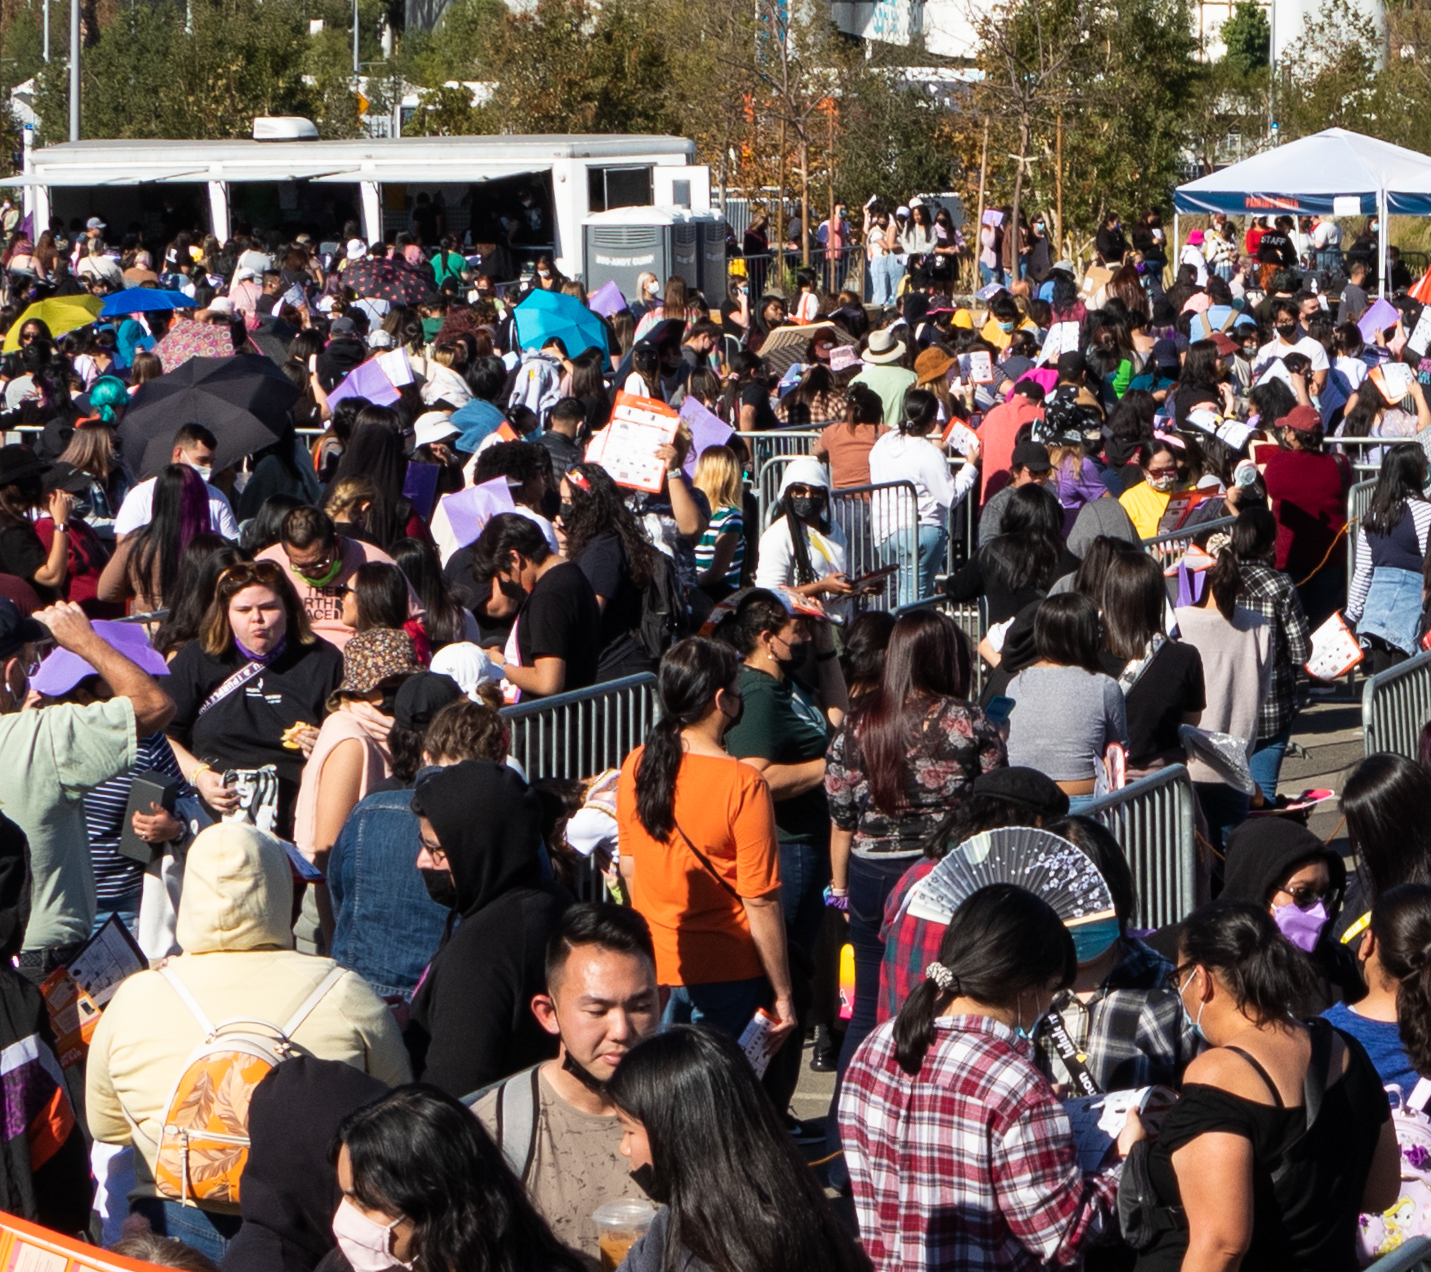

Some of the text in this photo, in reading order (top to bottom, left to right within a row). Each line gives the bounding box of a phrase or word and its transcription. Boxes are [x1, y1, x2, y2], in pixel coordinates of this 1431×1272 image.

[1261, 235, 1286, 246] STAFF
[306, 586, 335, 597] THE
[304, 597, 333, 608] RTH
